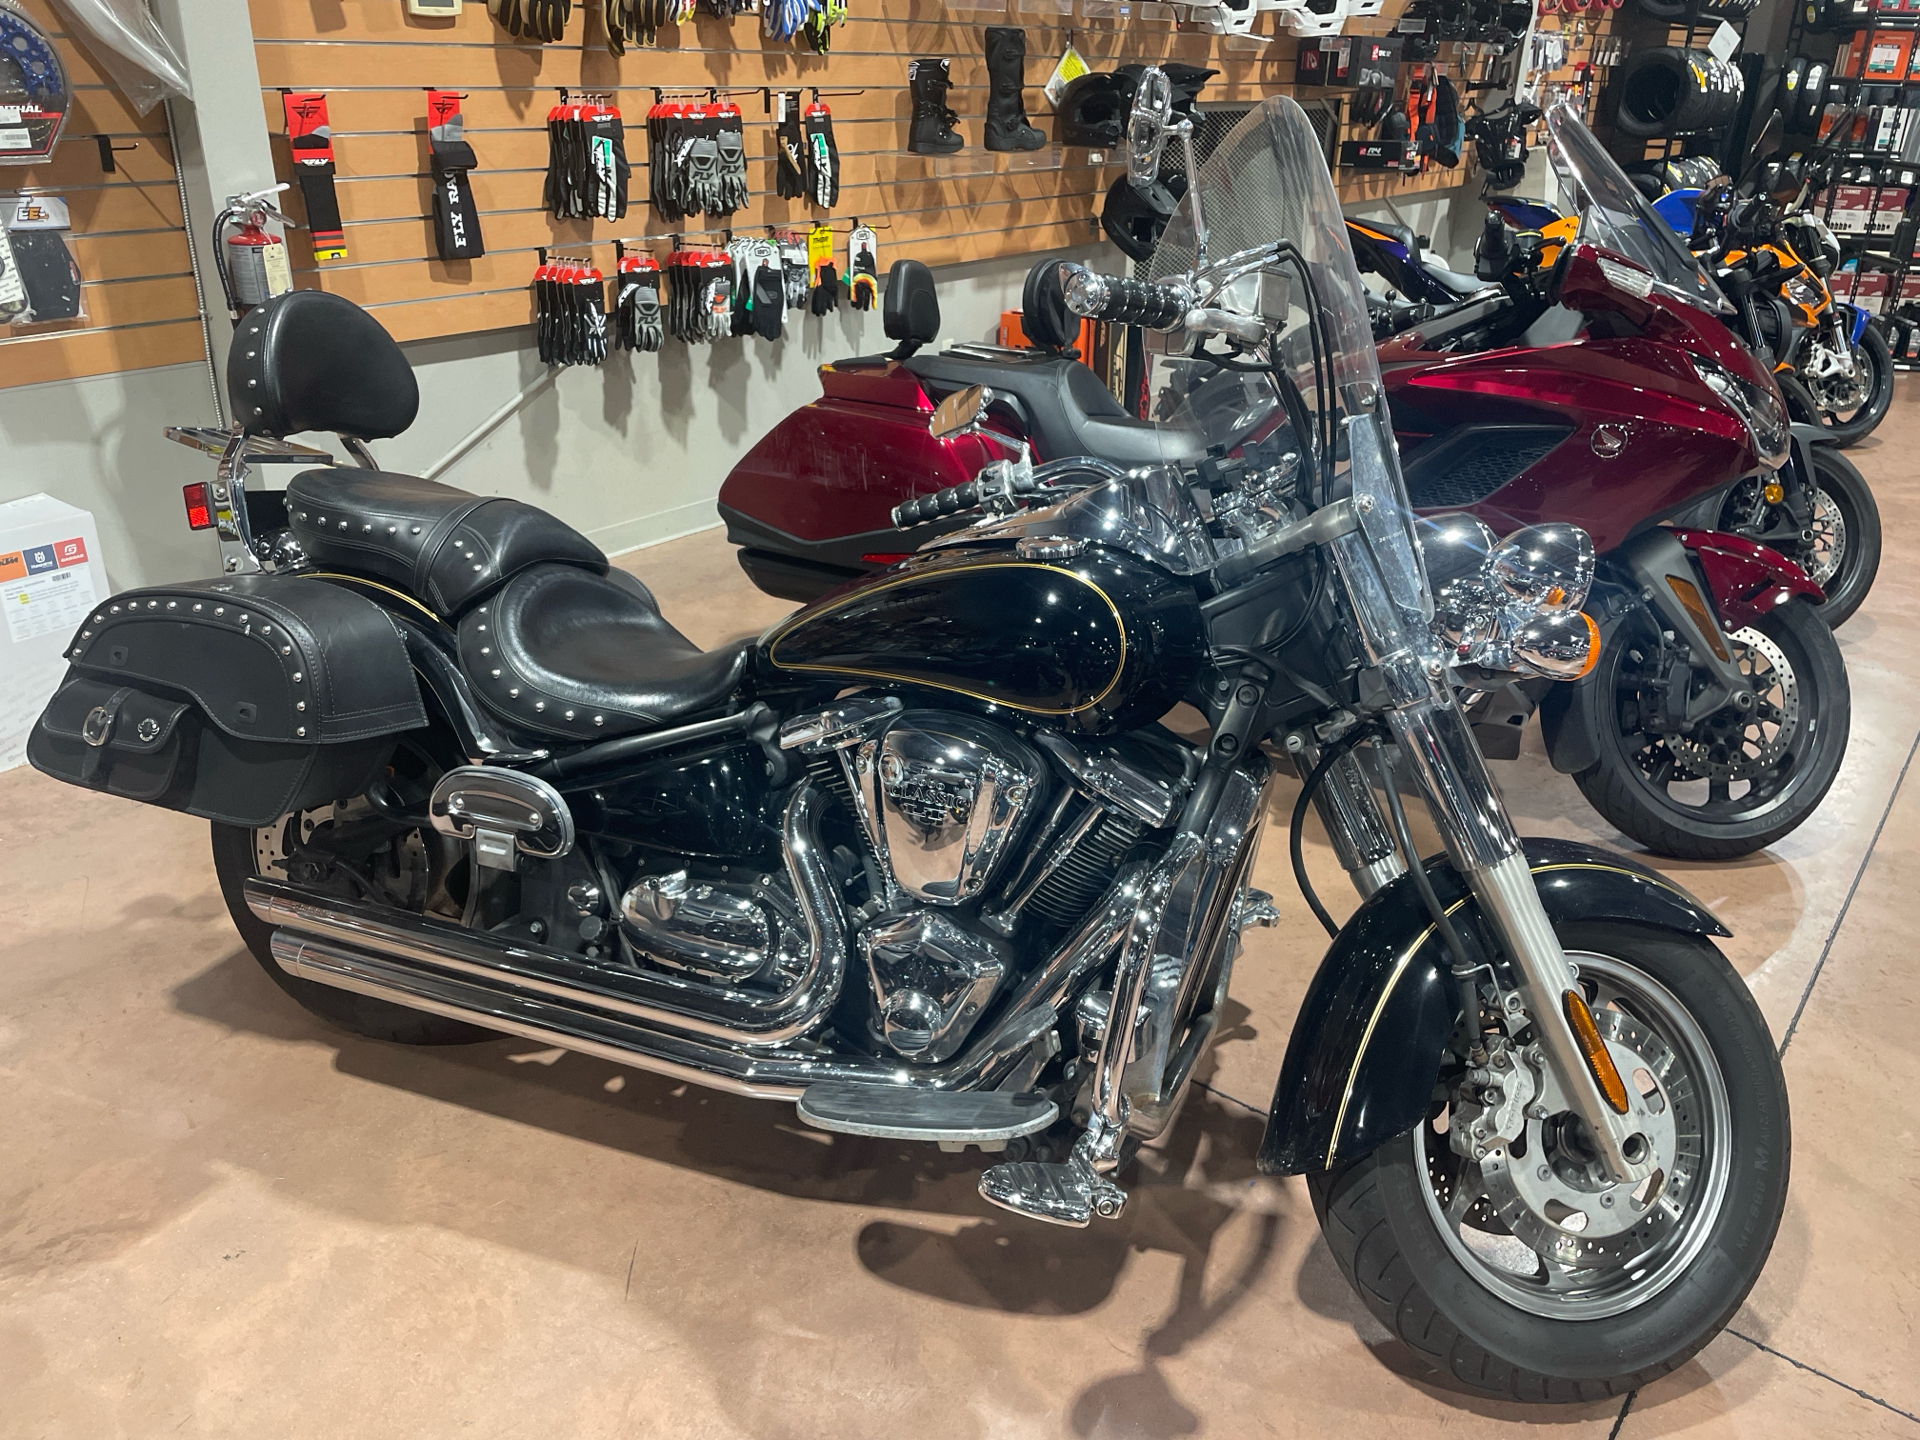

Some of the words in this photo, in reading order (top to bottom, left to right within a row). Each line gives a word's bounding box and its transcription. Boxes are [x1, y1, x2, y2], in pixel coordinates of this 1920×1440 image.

[719, 165, 741, 174] FLY
[692, 171, 714, 181] FLY
[450, 211, 467, 249] FLY
[813, 236, 829, 244] THOR
[638, 316, 659, 324] FLY
[889, 784, 970, 811] CLASSIC
[902, 803, 948, 821] LT
